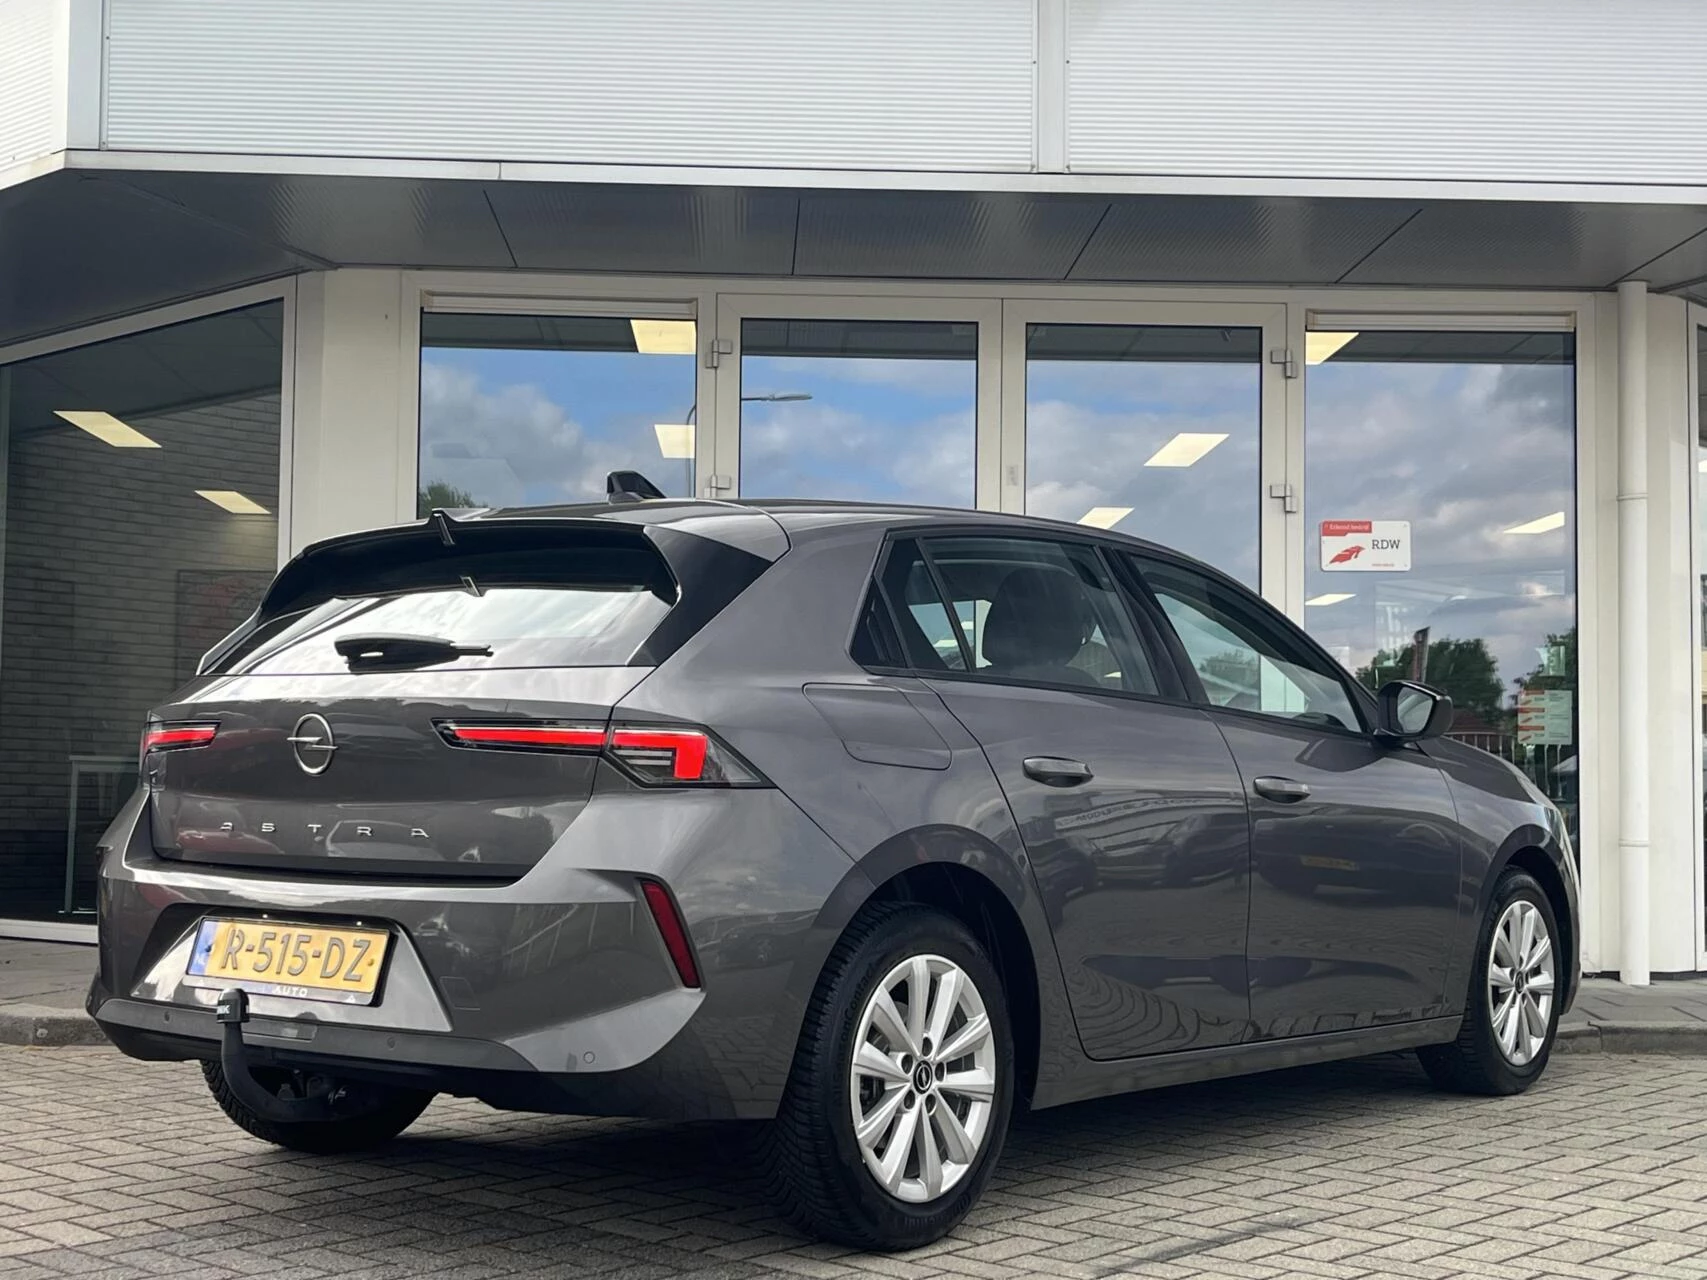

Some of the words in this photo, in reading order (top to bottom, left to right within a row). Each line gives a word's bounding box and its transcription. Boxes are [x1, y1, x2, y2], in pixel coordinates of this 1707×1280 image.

[1371, 539, 1401, 550] RDW
[219, 821, 430, 838] ASTRA
[221, 927, 372, 982] R-515-DZ
[273, 985, 308, 998] AUTO
